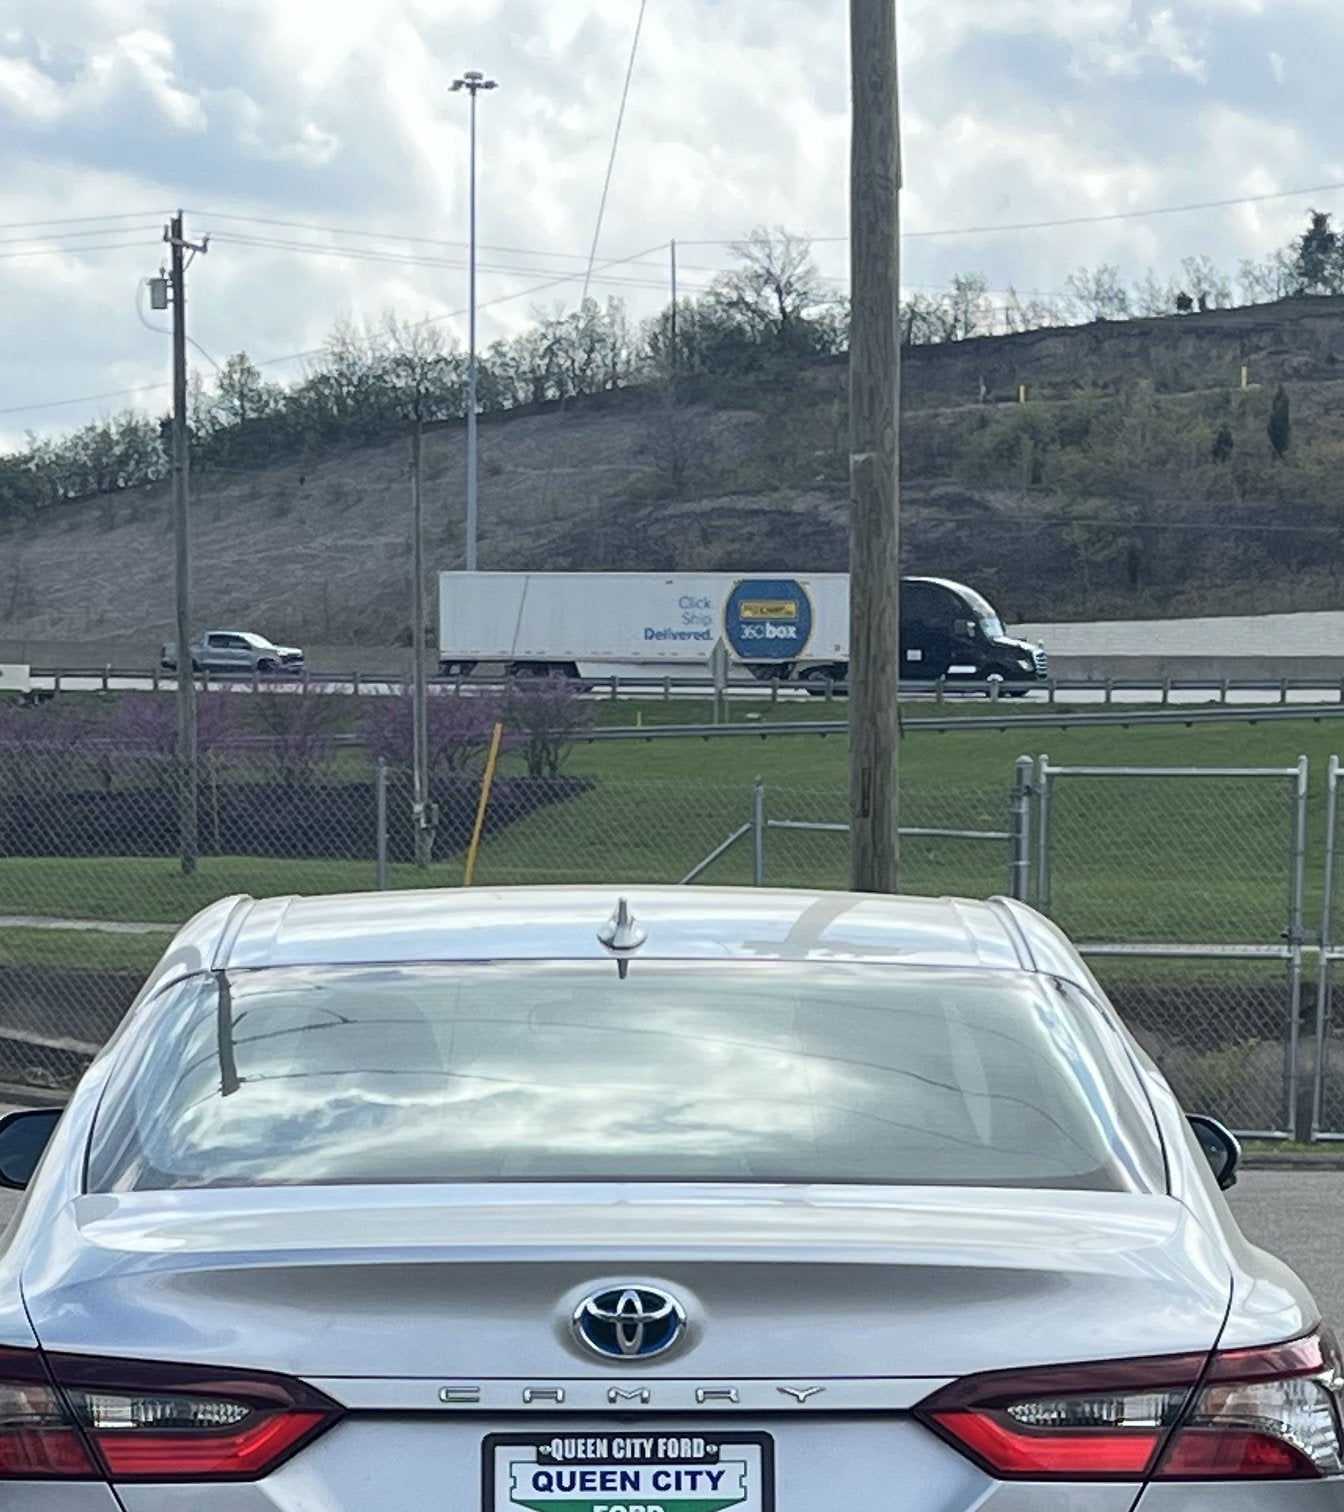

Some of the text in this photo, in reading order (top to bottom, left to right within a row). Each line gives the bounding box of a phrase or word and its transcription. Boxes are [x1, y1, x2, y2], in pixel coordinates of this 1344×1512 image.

[439, 1385, 826, 1404] CAMRY
[550, 1437, 706, 1461] QUEEN CITY FORD
[531, 1469, 726, 1493] QUEEN CITY
